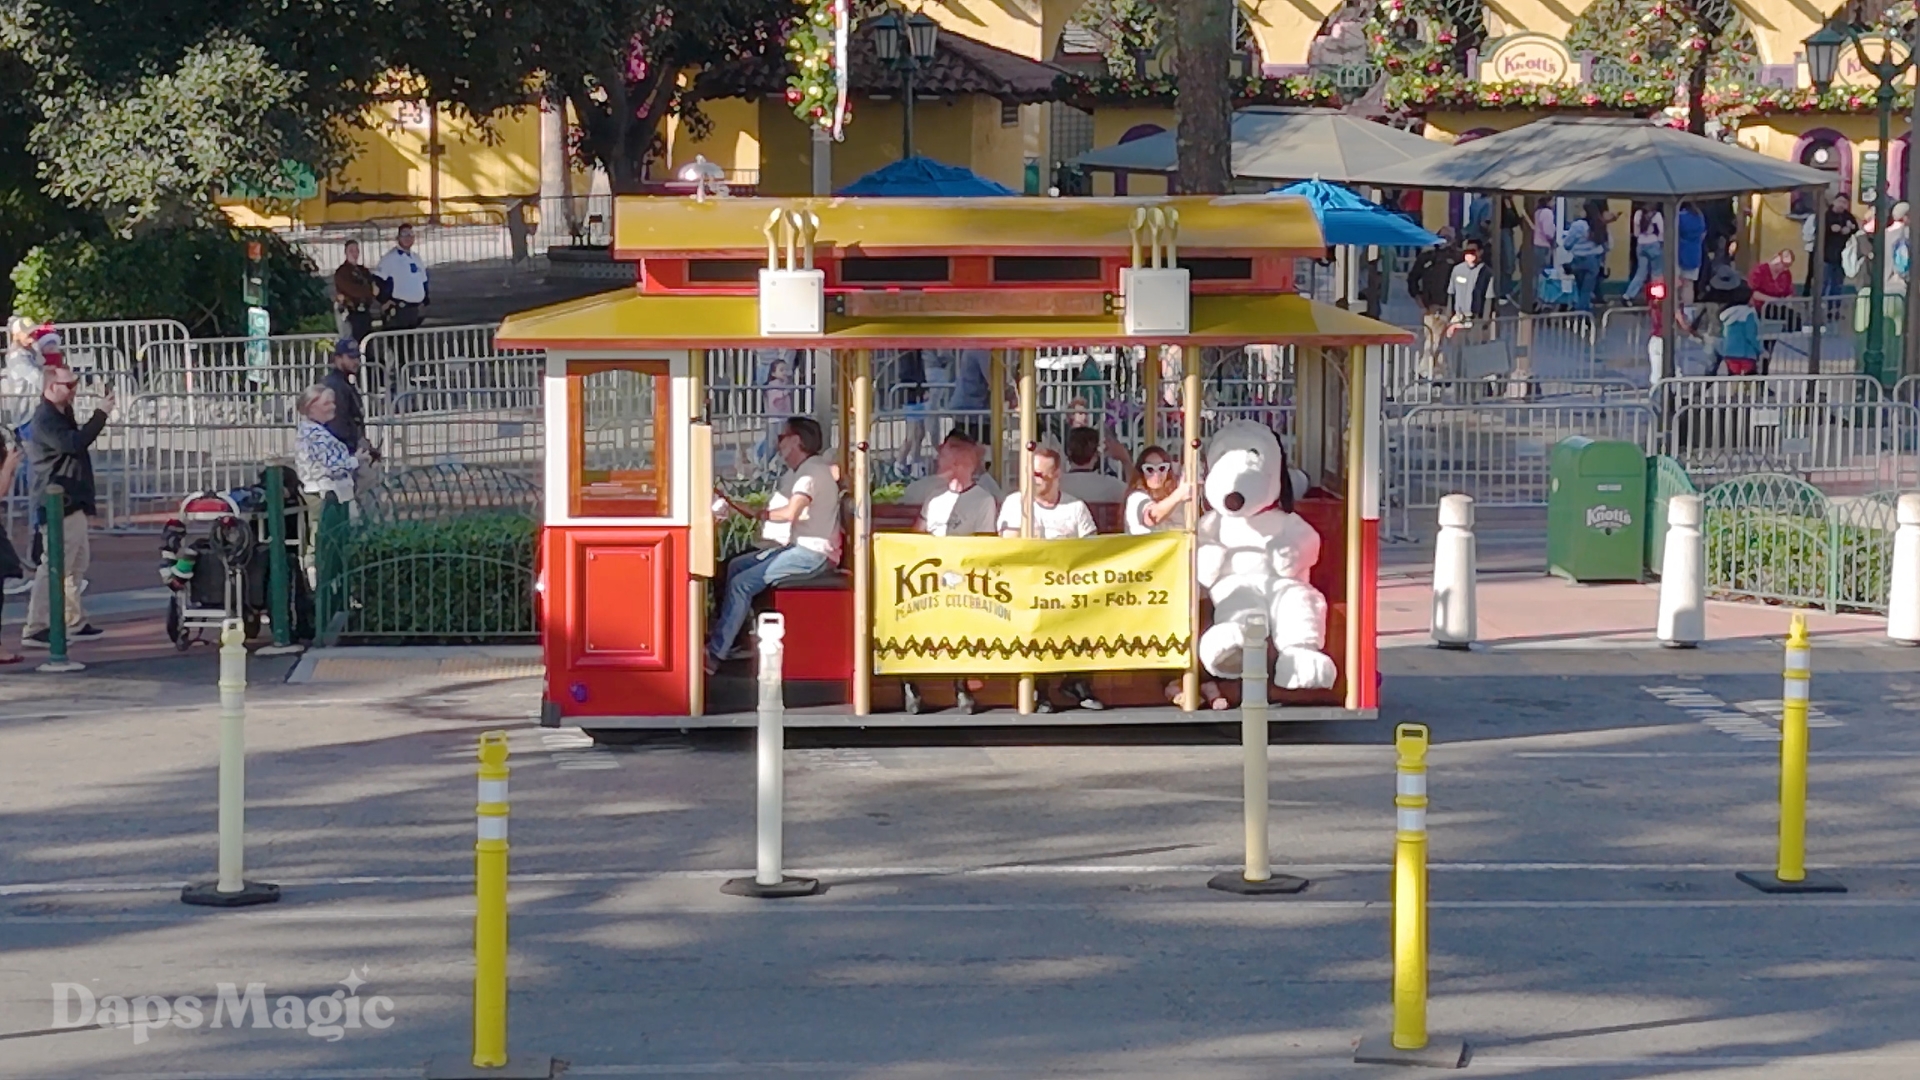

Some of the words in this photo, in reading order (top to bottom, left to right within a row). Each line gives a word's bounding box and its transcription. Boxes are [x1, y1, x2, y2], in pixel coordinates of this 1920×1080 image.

[1504, 52, 1557, 74] Knott's
[1586, 504, 1632, 527] Knott's
[894, 558, 1013, 606] Kntt's
[1044, 570, 1099, 586] Select
[1104, 569, 1154, 584] Dates
[895, 595, 940, 621] PEANUTS
[945, 594, 1012, 621] CELEBRATION
[1029, 595, 1066, 609] Jan.
[1071, 594, 1089, 609] 31
[1105, 590, 1142, 607] Feb.
[1147, 590, 1169, 605] 22
